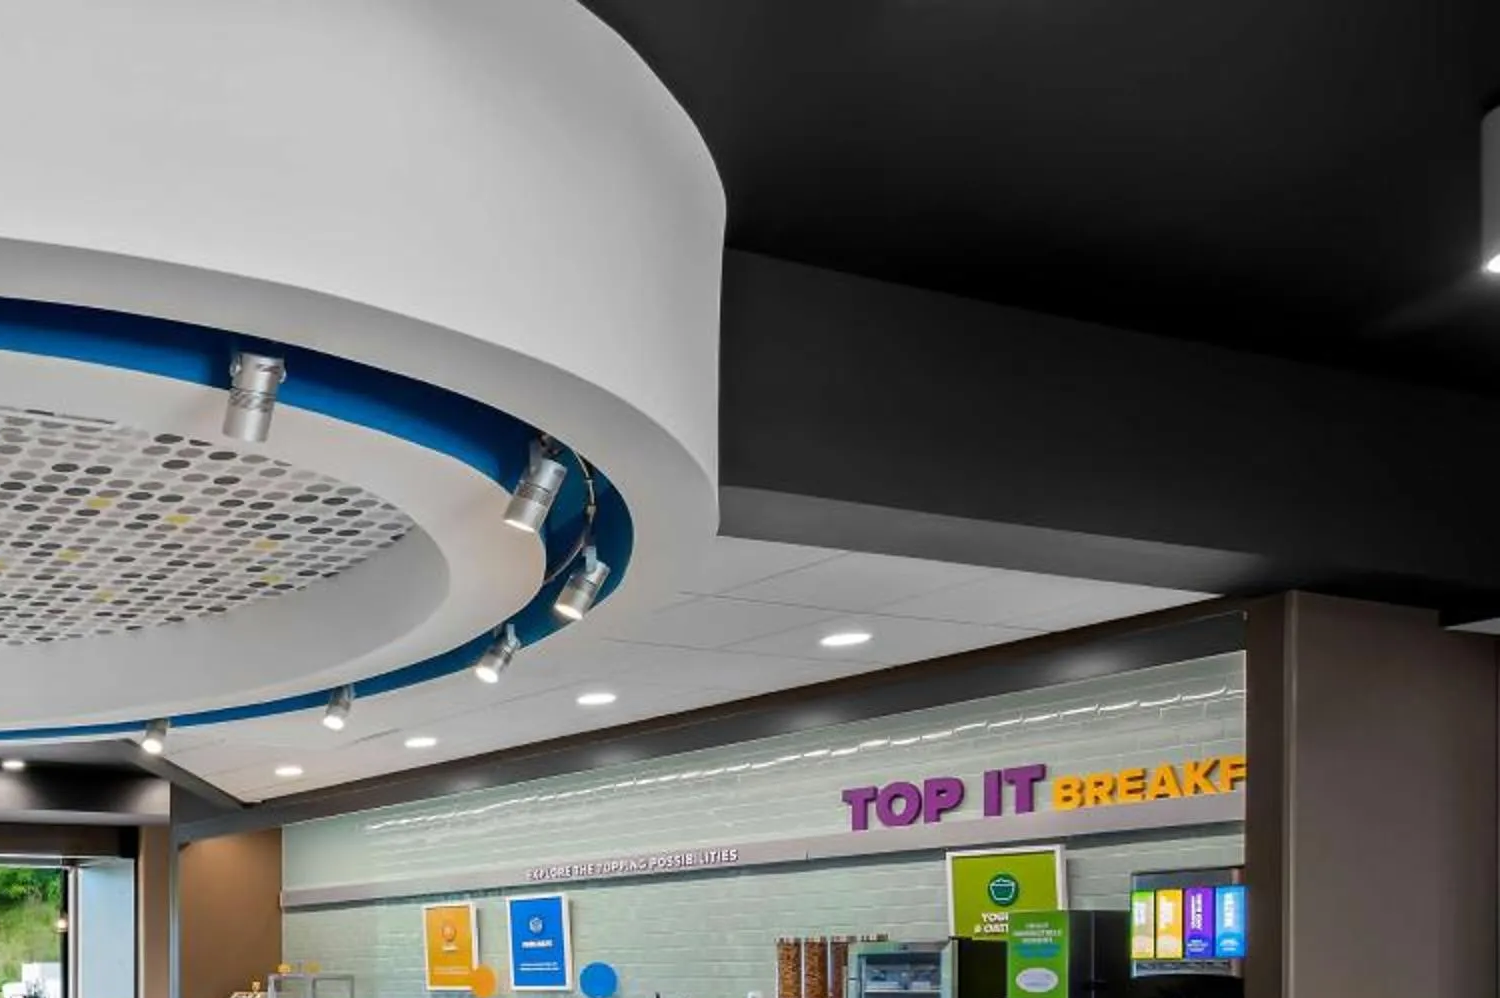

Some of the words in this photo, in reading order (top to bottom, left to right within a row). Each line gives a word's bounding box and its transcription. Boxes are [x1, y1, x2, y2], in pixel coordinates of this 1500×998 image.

[842, 776, 965, 832] TOP
[984, 763, 1047, 818] IT
[1053, 753, 1247, 813] BREAKF
[525, 864, 573, 881] EXPLORE
[573, 862, 595, 877] THE
[595, 857, 648, 875] TOPPING
[648, 848, 739, 870] POSSIBILITIES
